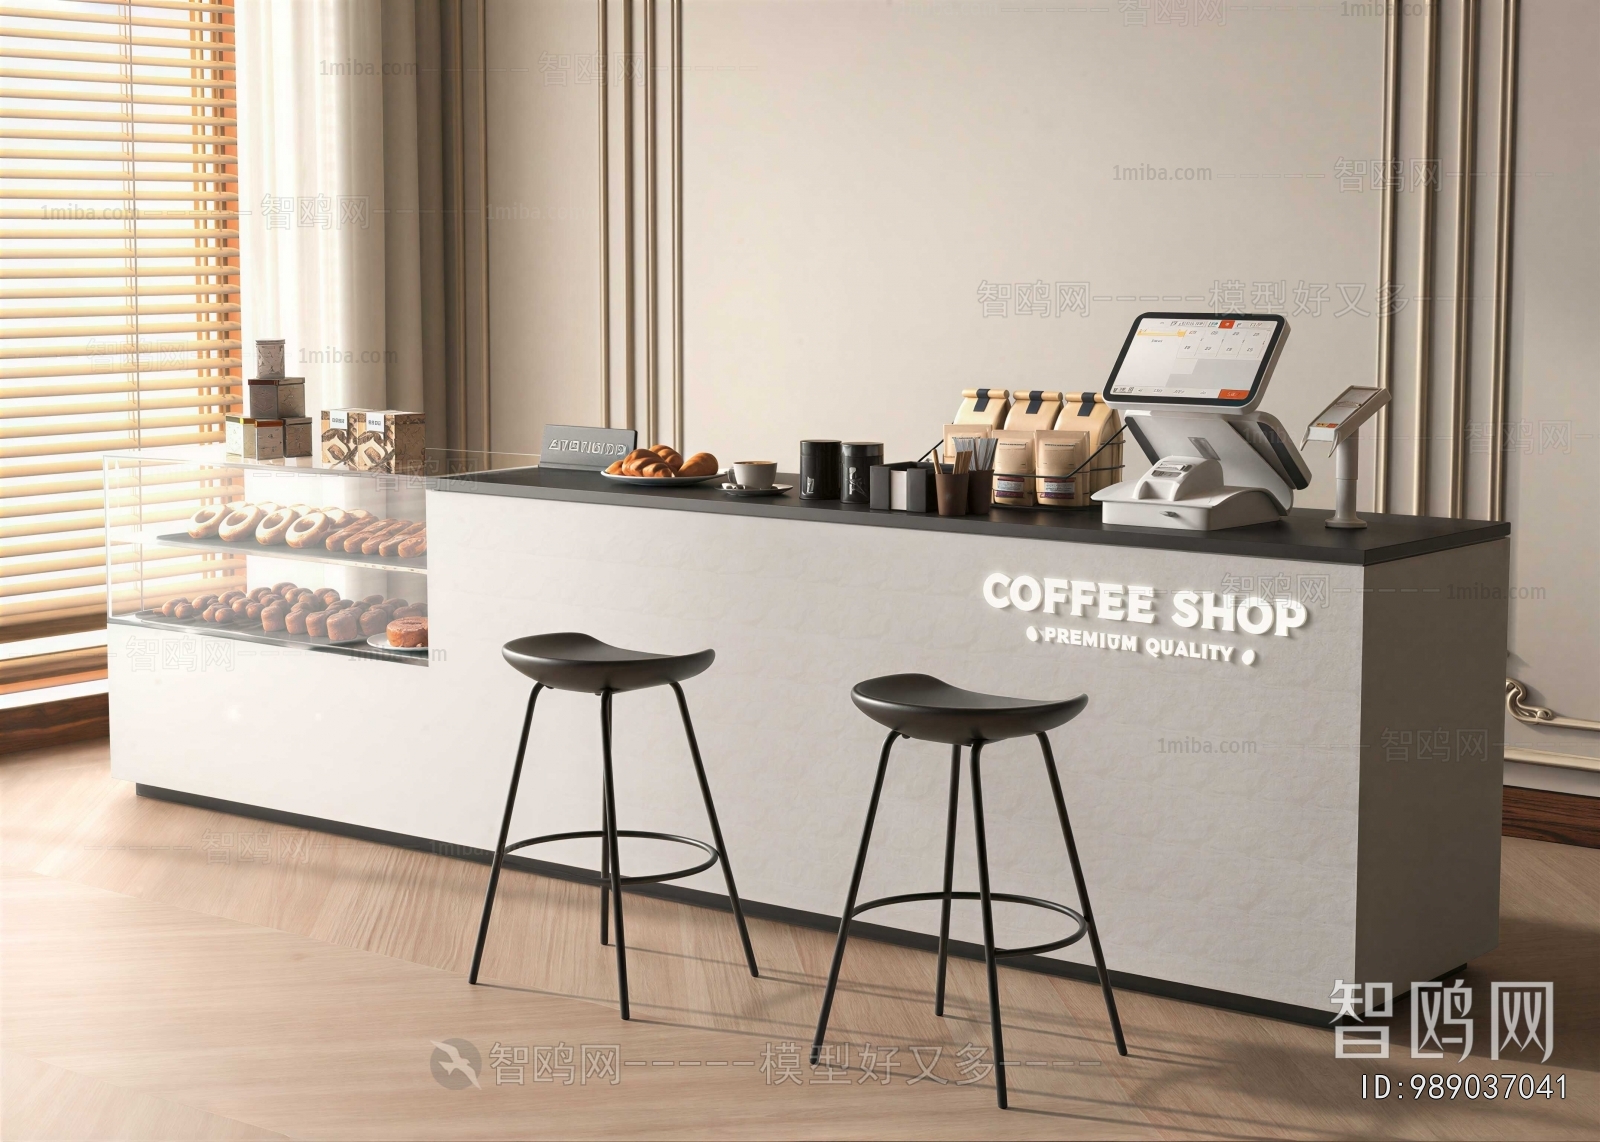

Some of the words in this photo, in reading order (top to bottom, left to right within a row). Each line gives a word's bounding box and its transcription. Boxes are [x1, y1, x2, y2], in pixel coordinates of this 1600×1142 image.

[983, 572, 1156, 624] COFFEE
[1171, 588, 1308, 638] SHOP
[1044, 626, 1138, 653] PREMIUM
[1146, 637, 1235, 662] QUALITY
